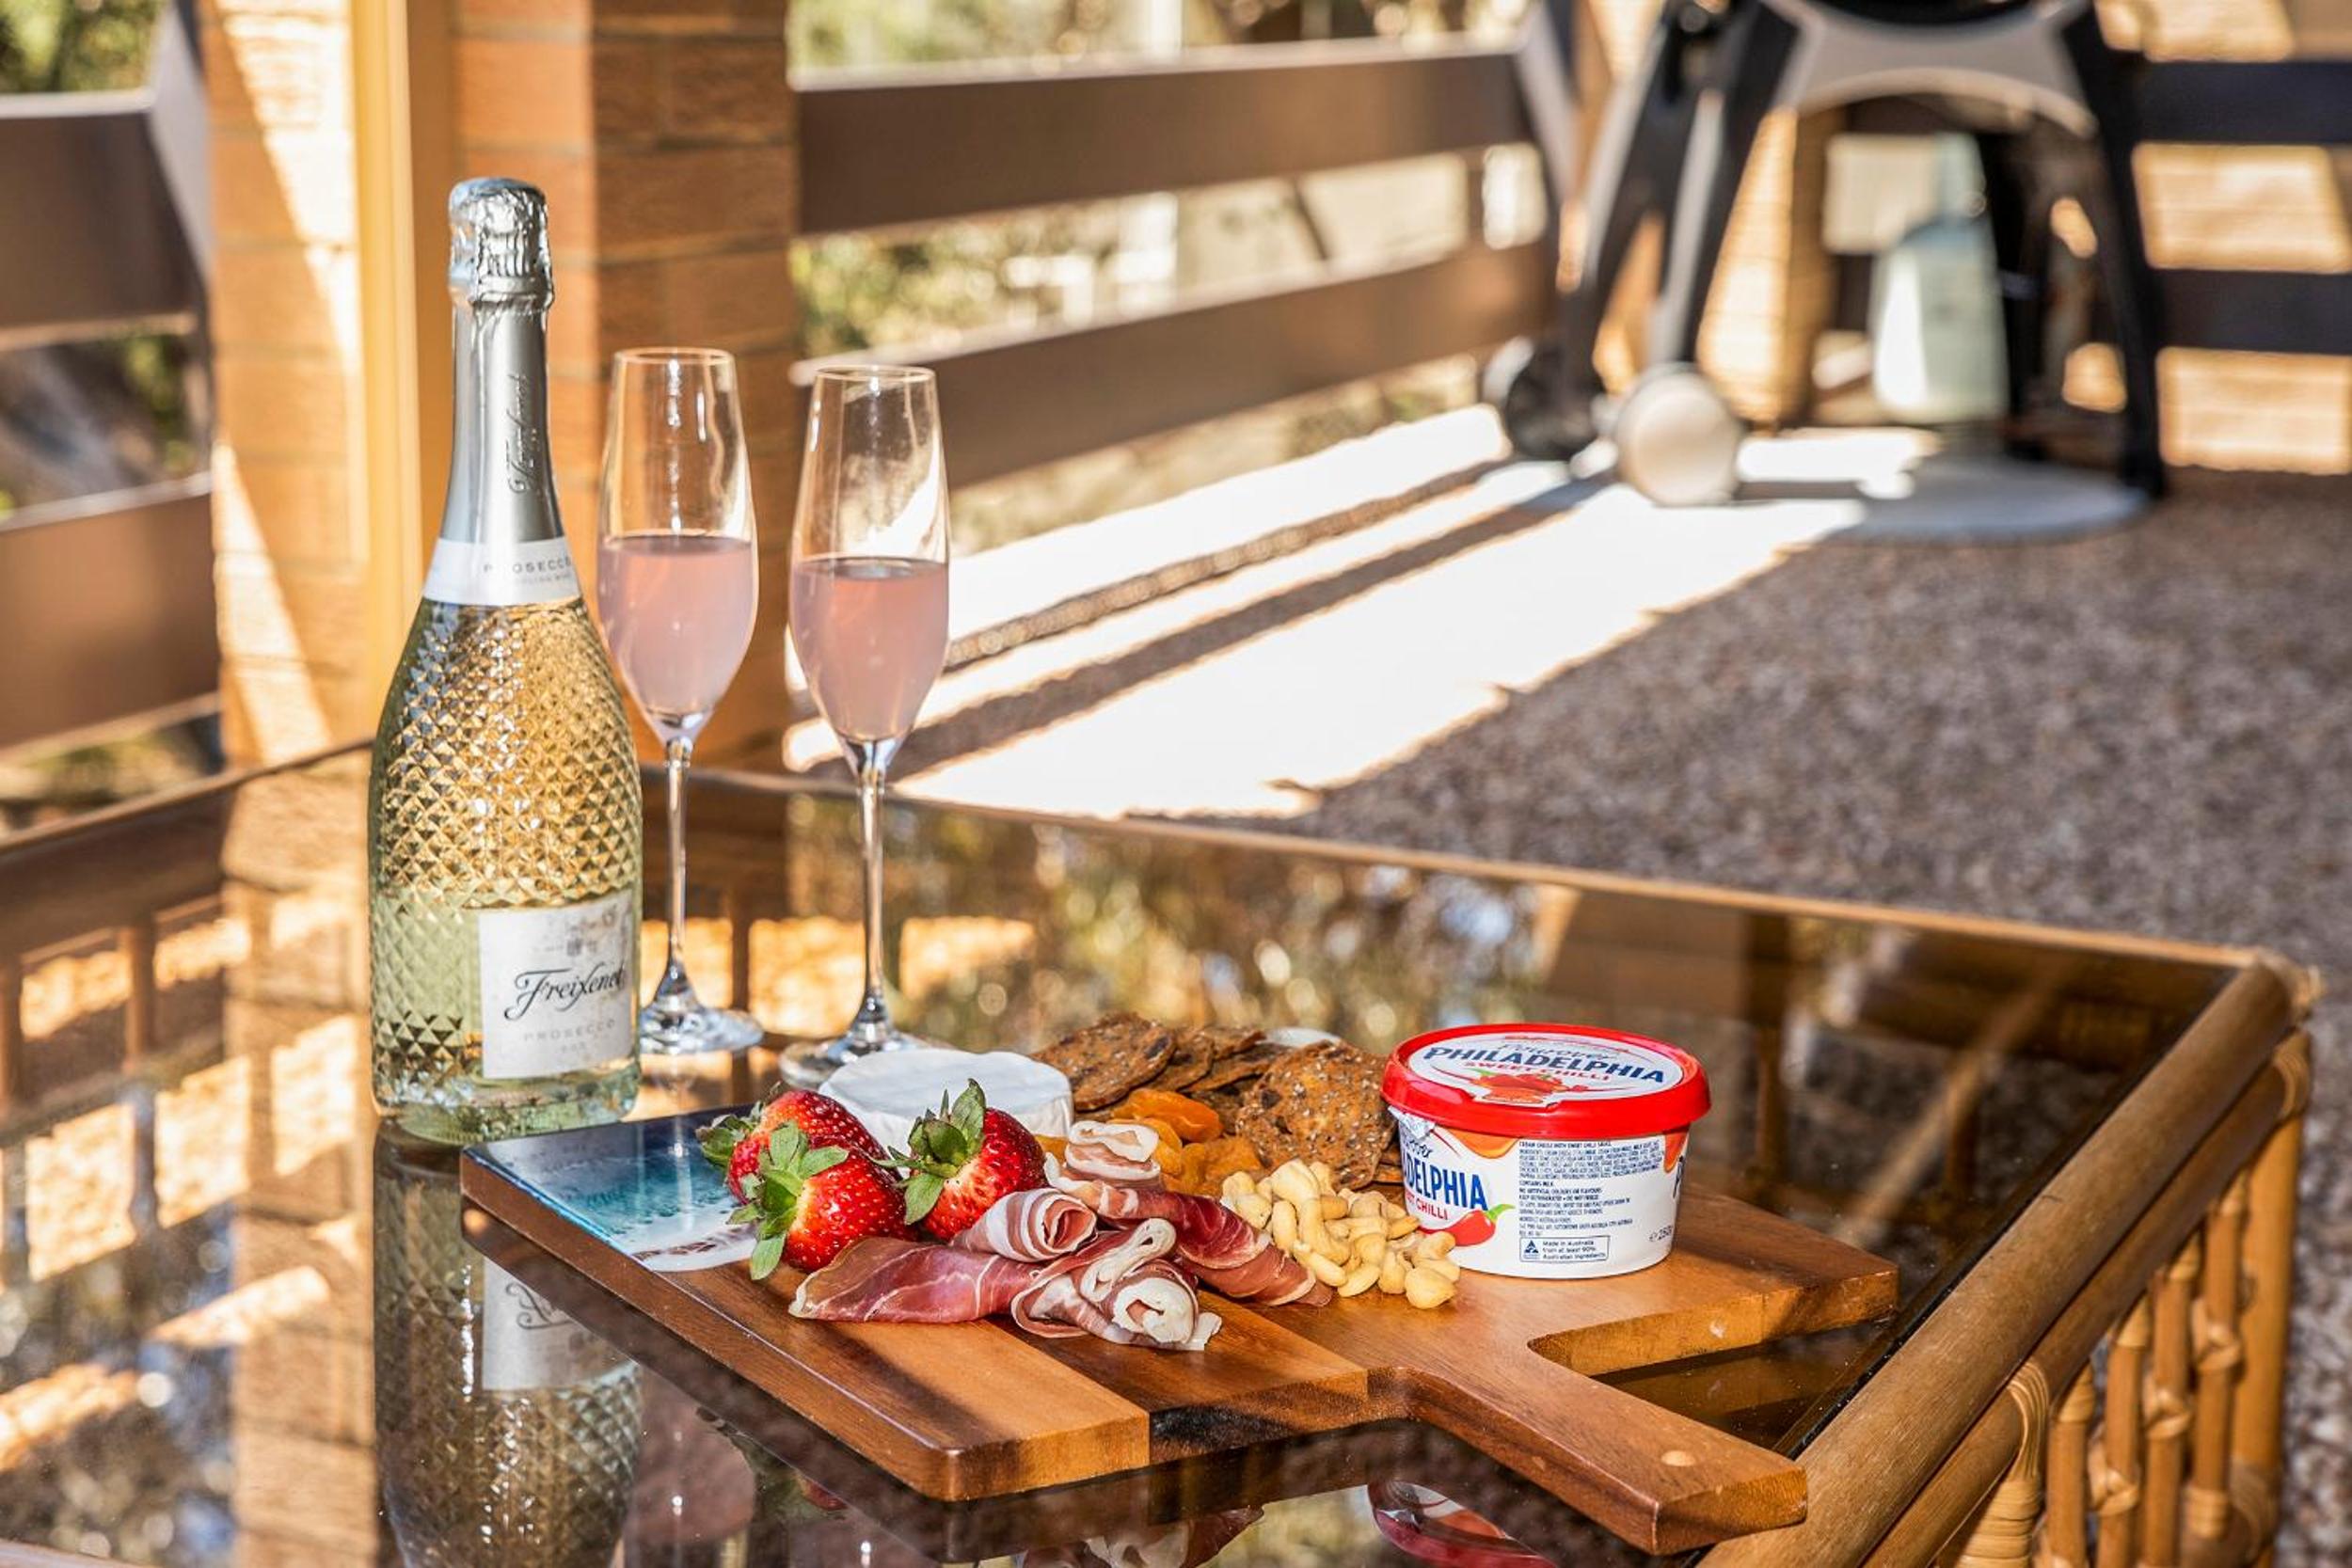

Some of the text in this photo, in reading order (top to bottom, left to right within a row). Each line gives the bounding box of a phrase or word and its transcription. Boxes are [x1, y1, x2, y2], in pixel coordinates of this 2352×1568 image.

[483, 556, 572, 575] POSECCO
[523, 1018, 615, 1042] PROSECCO
[1422, 1046, 1664, 1084] PHILADELPHIA
[1465, 1061, 1610, 1081] SWEET CHILLI
[1404, 1152, 1489, 1211] DELPHIA
[1417, 1197, 1449, 1221] CHILLI
